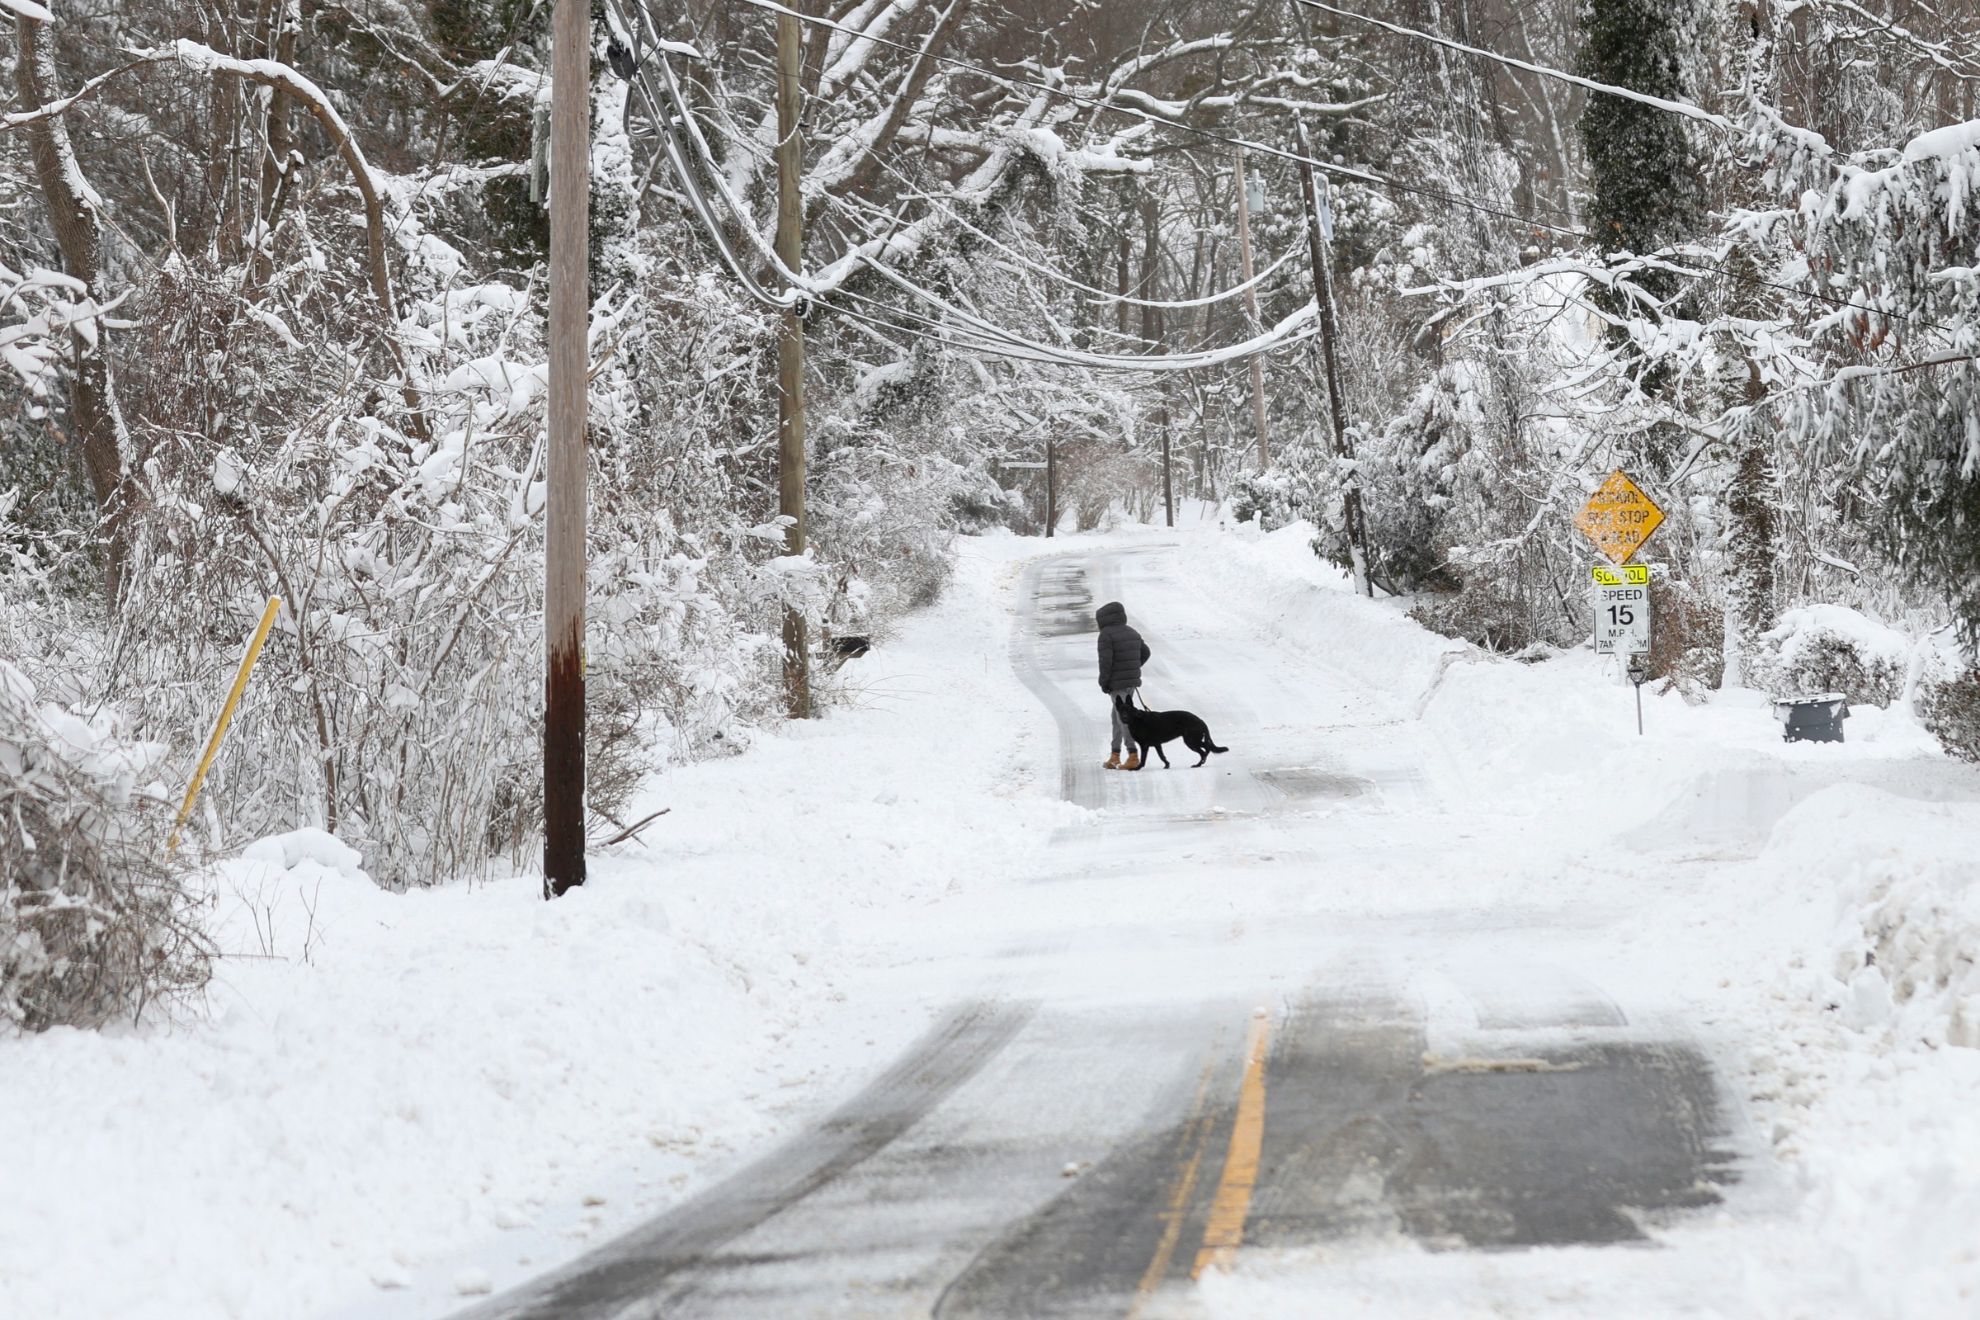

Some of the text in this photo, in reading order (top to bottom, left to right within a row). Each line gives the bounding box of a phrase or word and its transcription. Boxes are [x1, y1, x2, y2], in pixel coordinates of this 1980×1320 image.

[1619, 510, 1649, 523] STOP
[1595, 570, 1643, 582] SCOL
[1600, 590, 1642, 601] SPEED
[1607, 604, 1634, 625] 15
